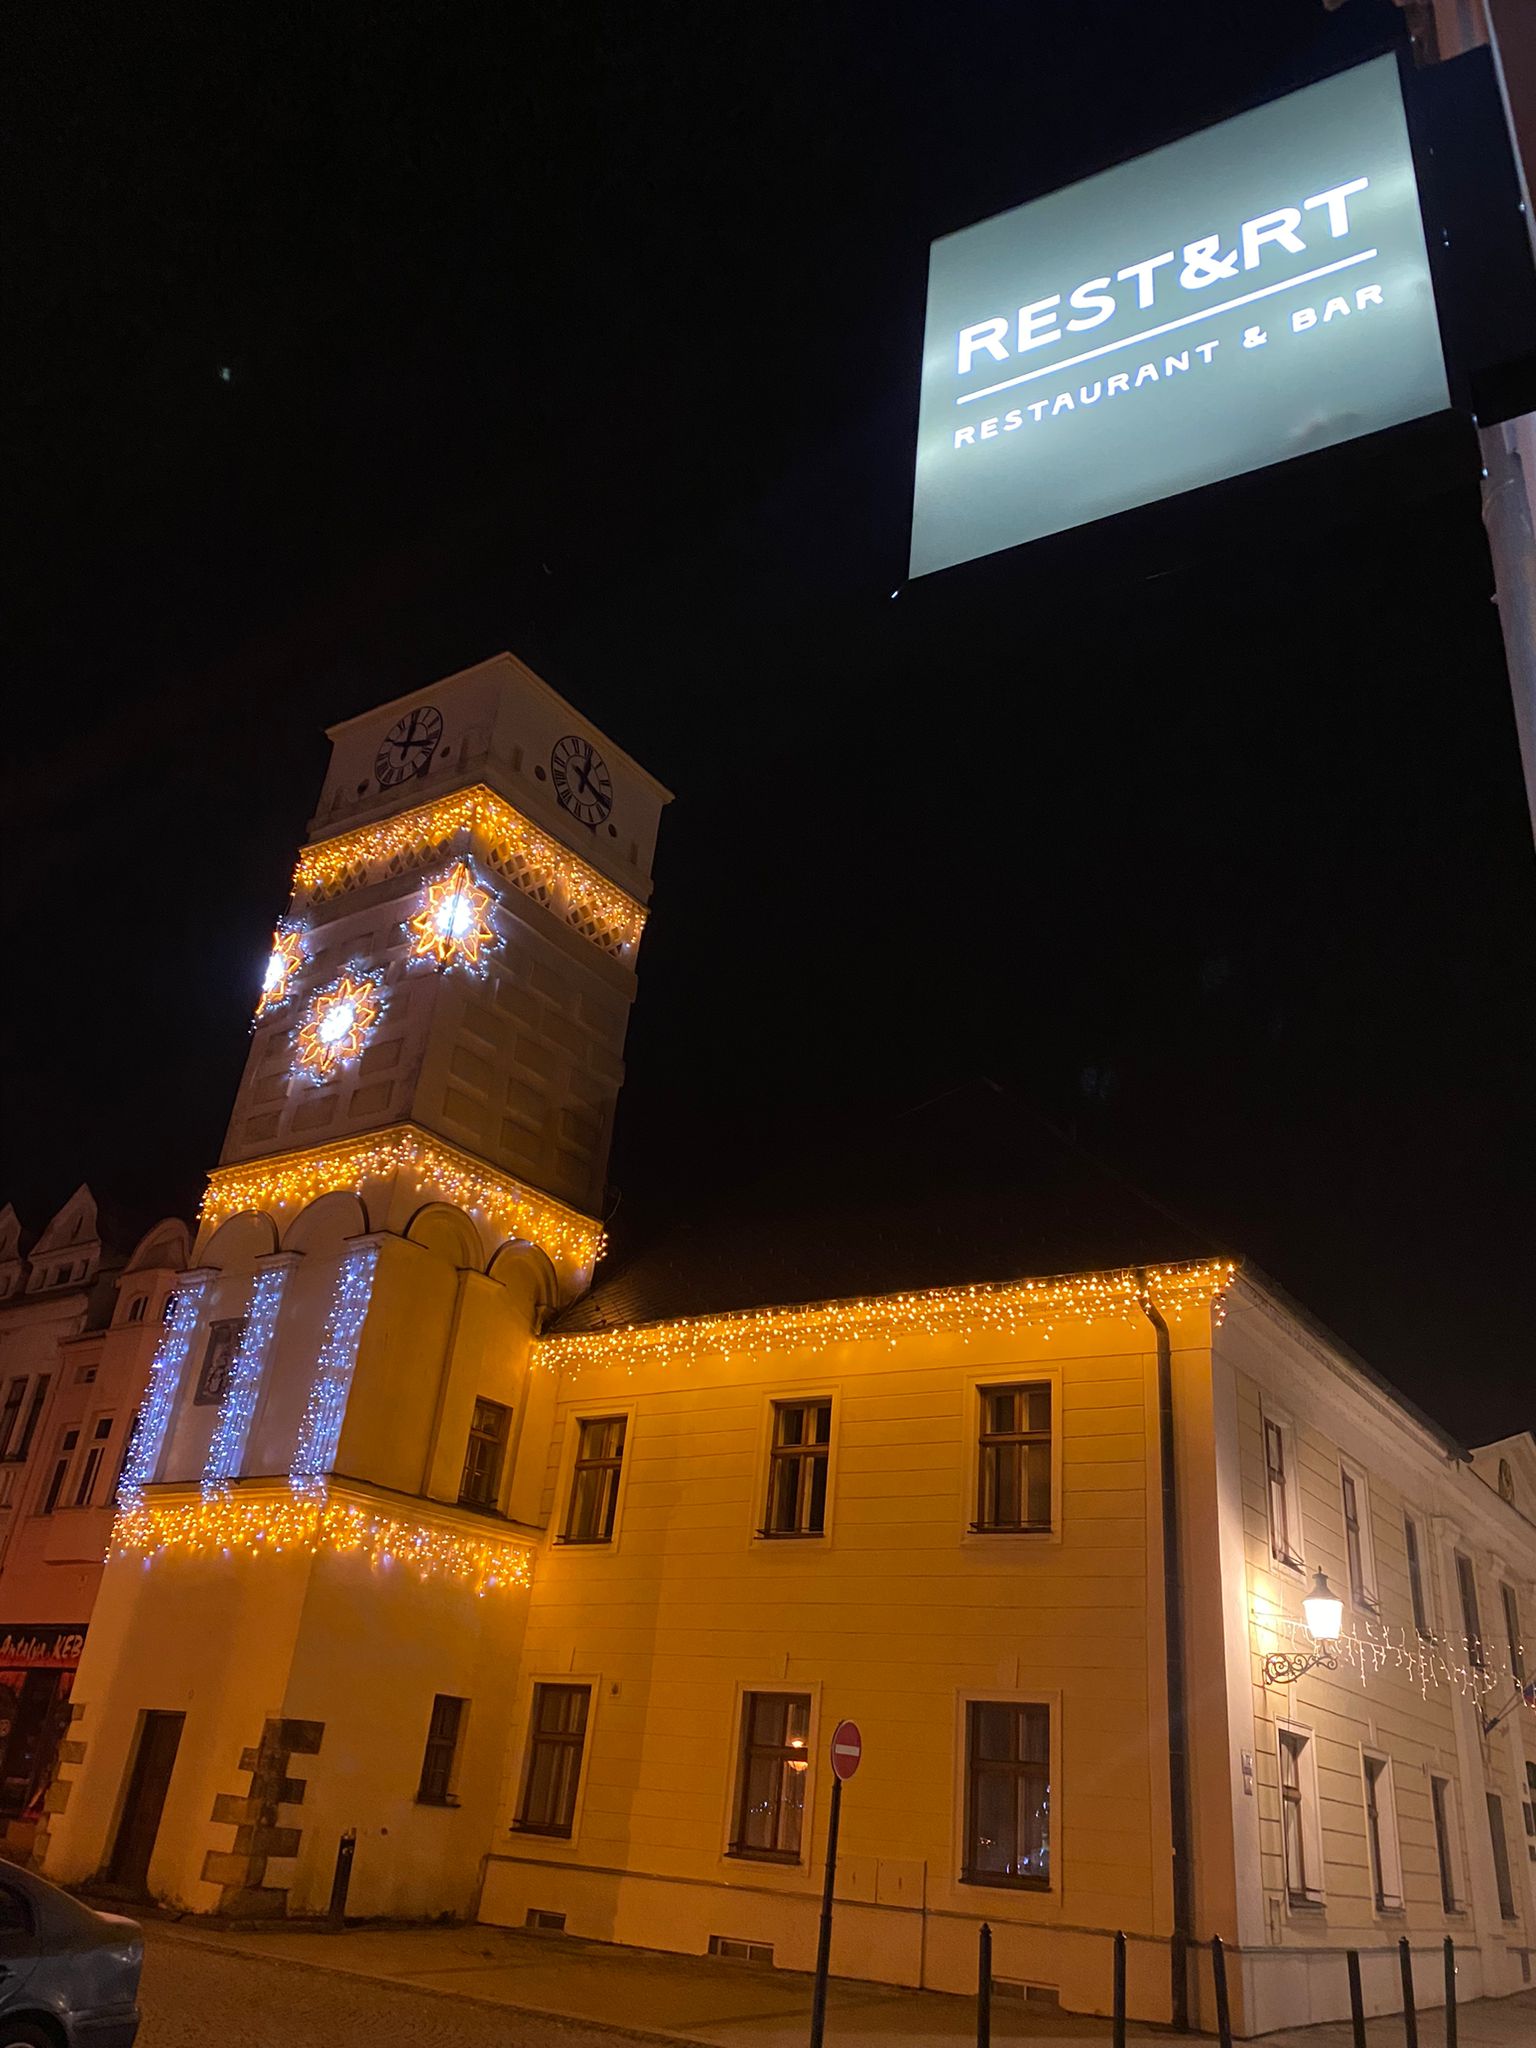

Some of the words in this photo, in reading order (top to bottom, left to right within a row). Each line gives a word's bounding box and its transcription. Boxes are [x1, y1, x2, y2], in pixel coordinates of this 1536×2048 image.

[953, 340, 1220, 449] RESTAURANT
[1242, 325, 1268, 349] &
[1291, 283, 1385, 333] BAR
[956, 176, 1370, 375] REST&RT
